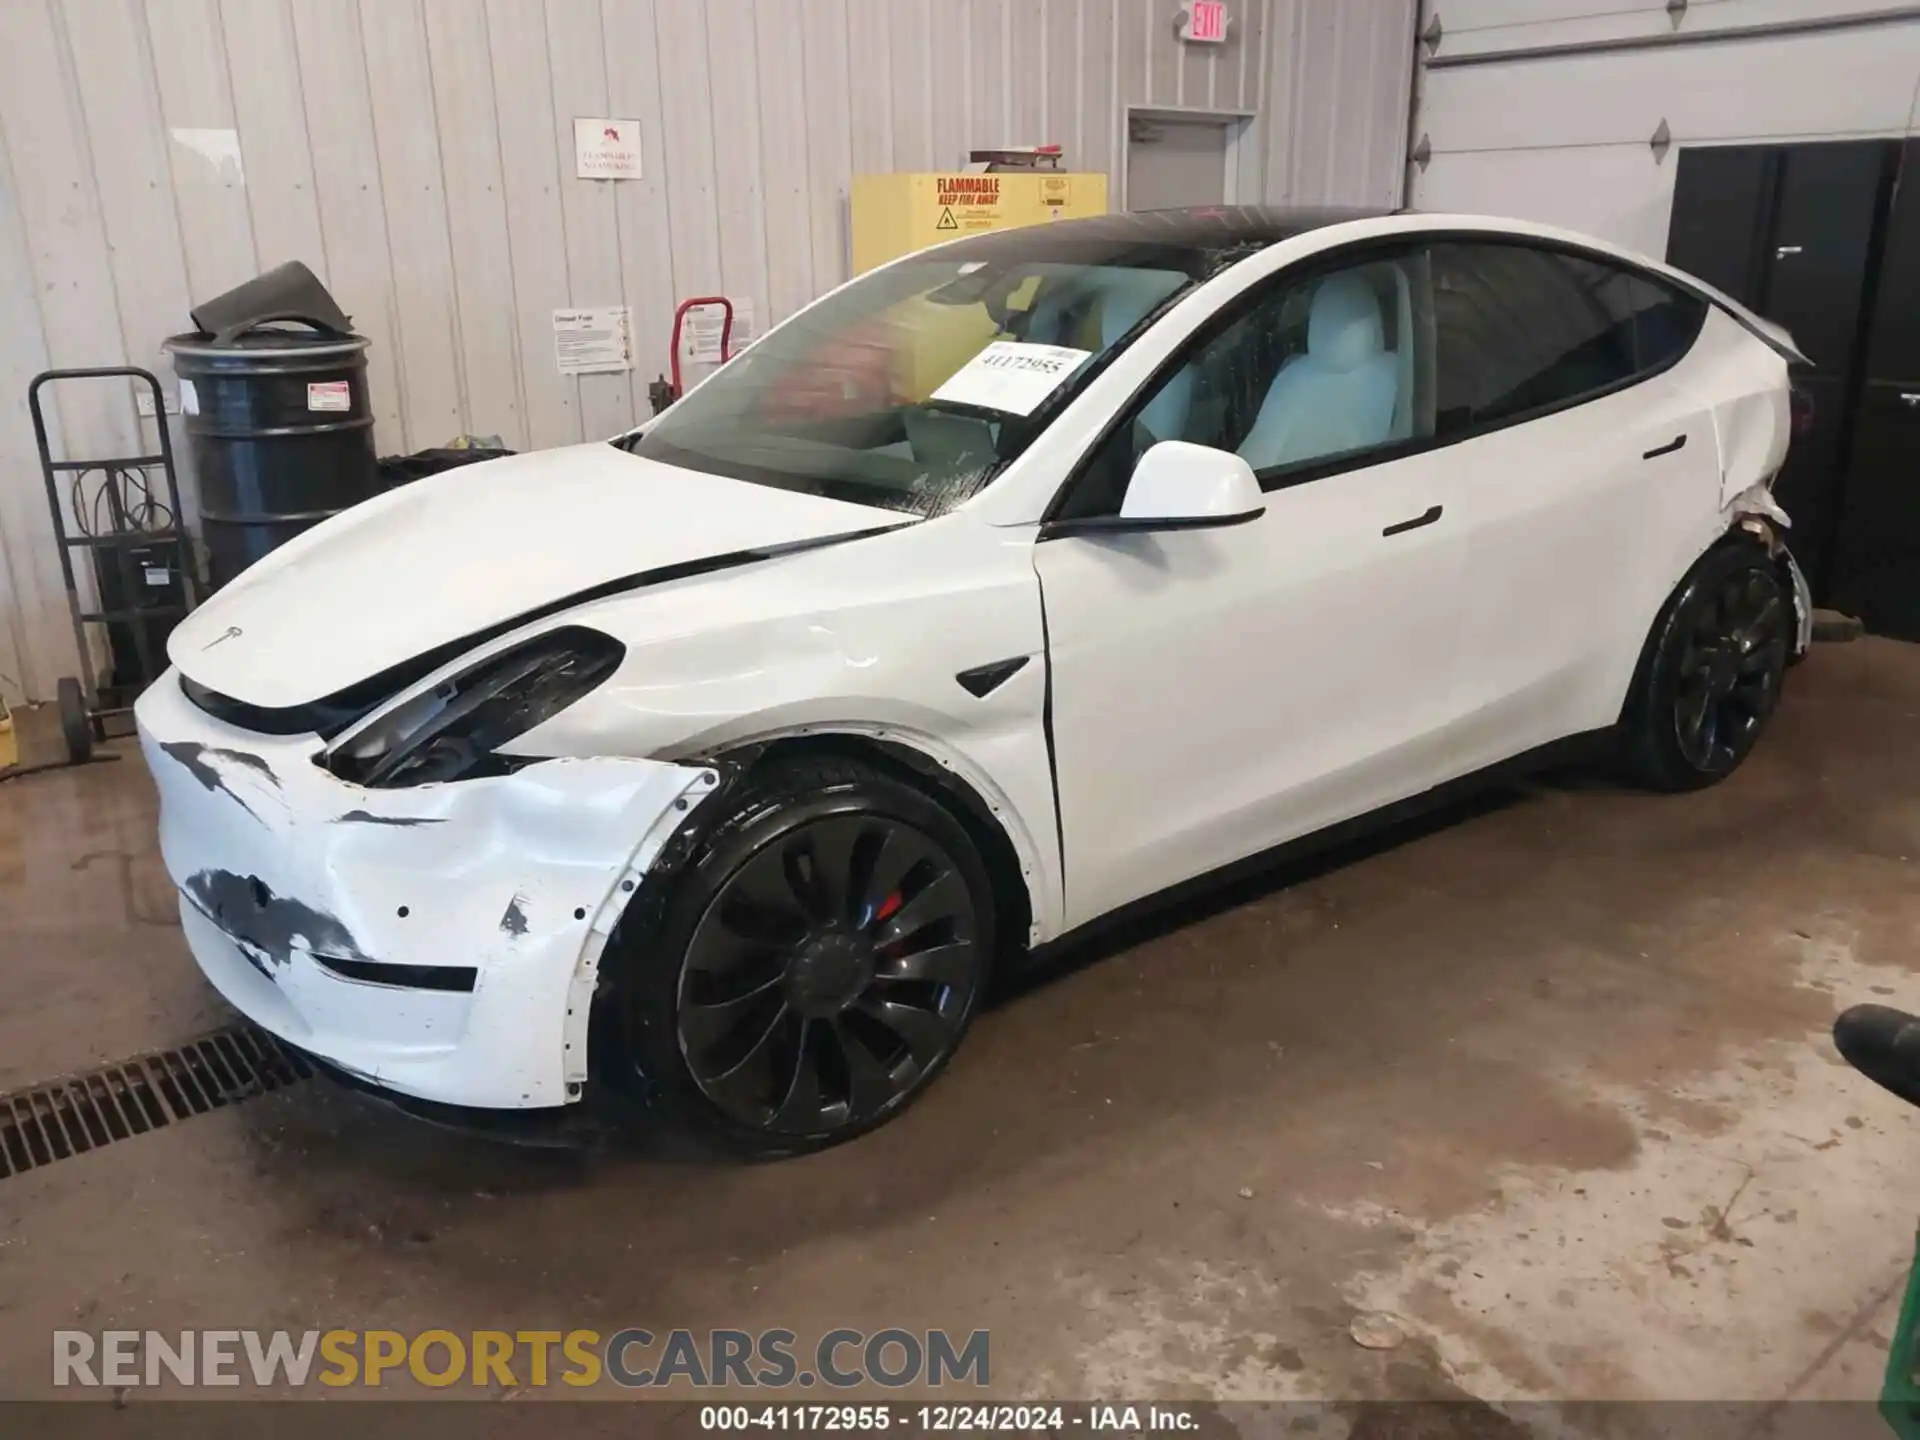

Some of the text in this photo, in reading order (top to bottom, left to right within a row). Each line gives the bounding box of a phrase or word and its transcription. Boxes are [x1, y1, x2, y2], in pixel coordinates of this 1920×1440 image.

[1193, 3, 1222, 36] EXIT
[937, 178, 999, 193] FLAMMABLE
[938, 194, 999, 205] KEEP FIRE AWAY
[983, 354, 1064, 374] 41172955
